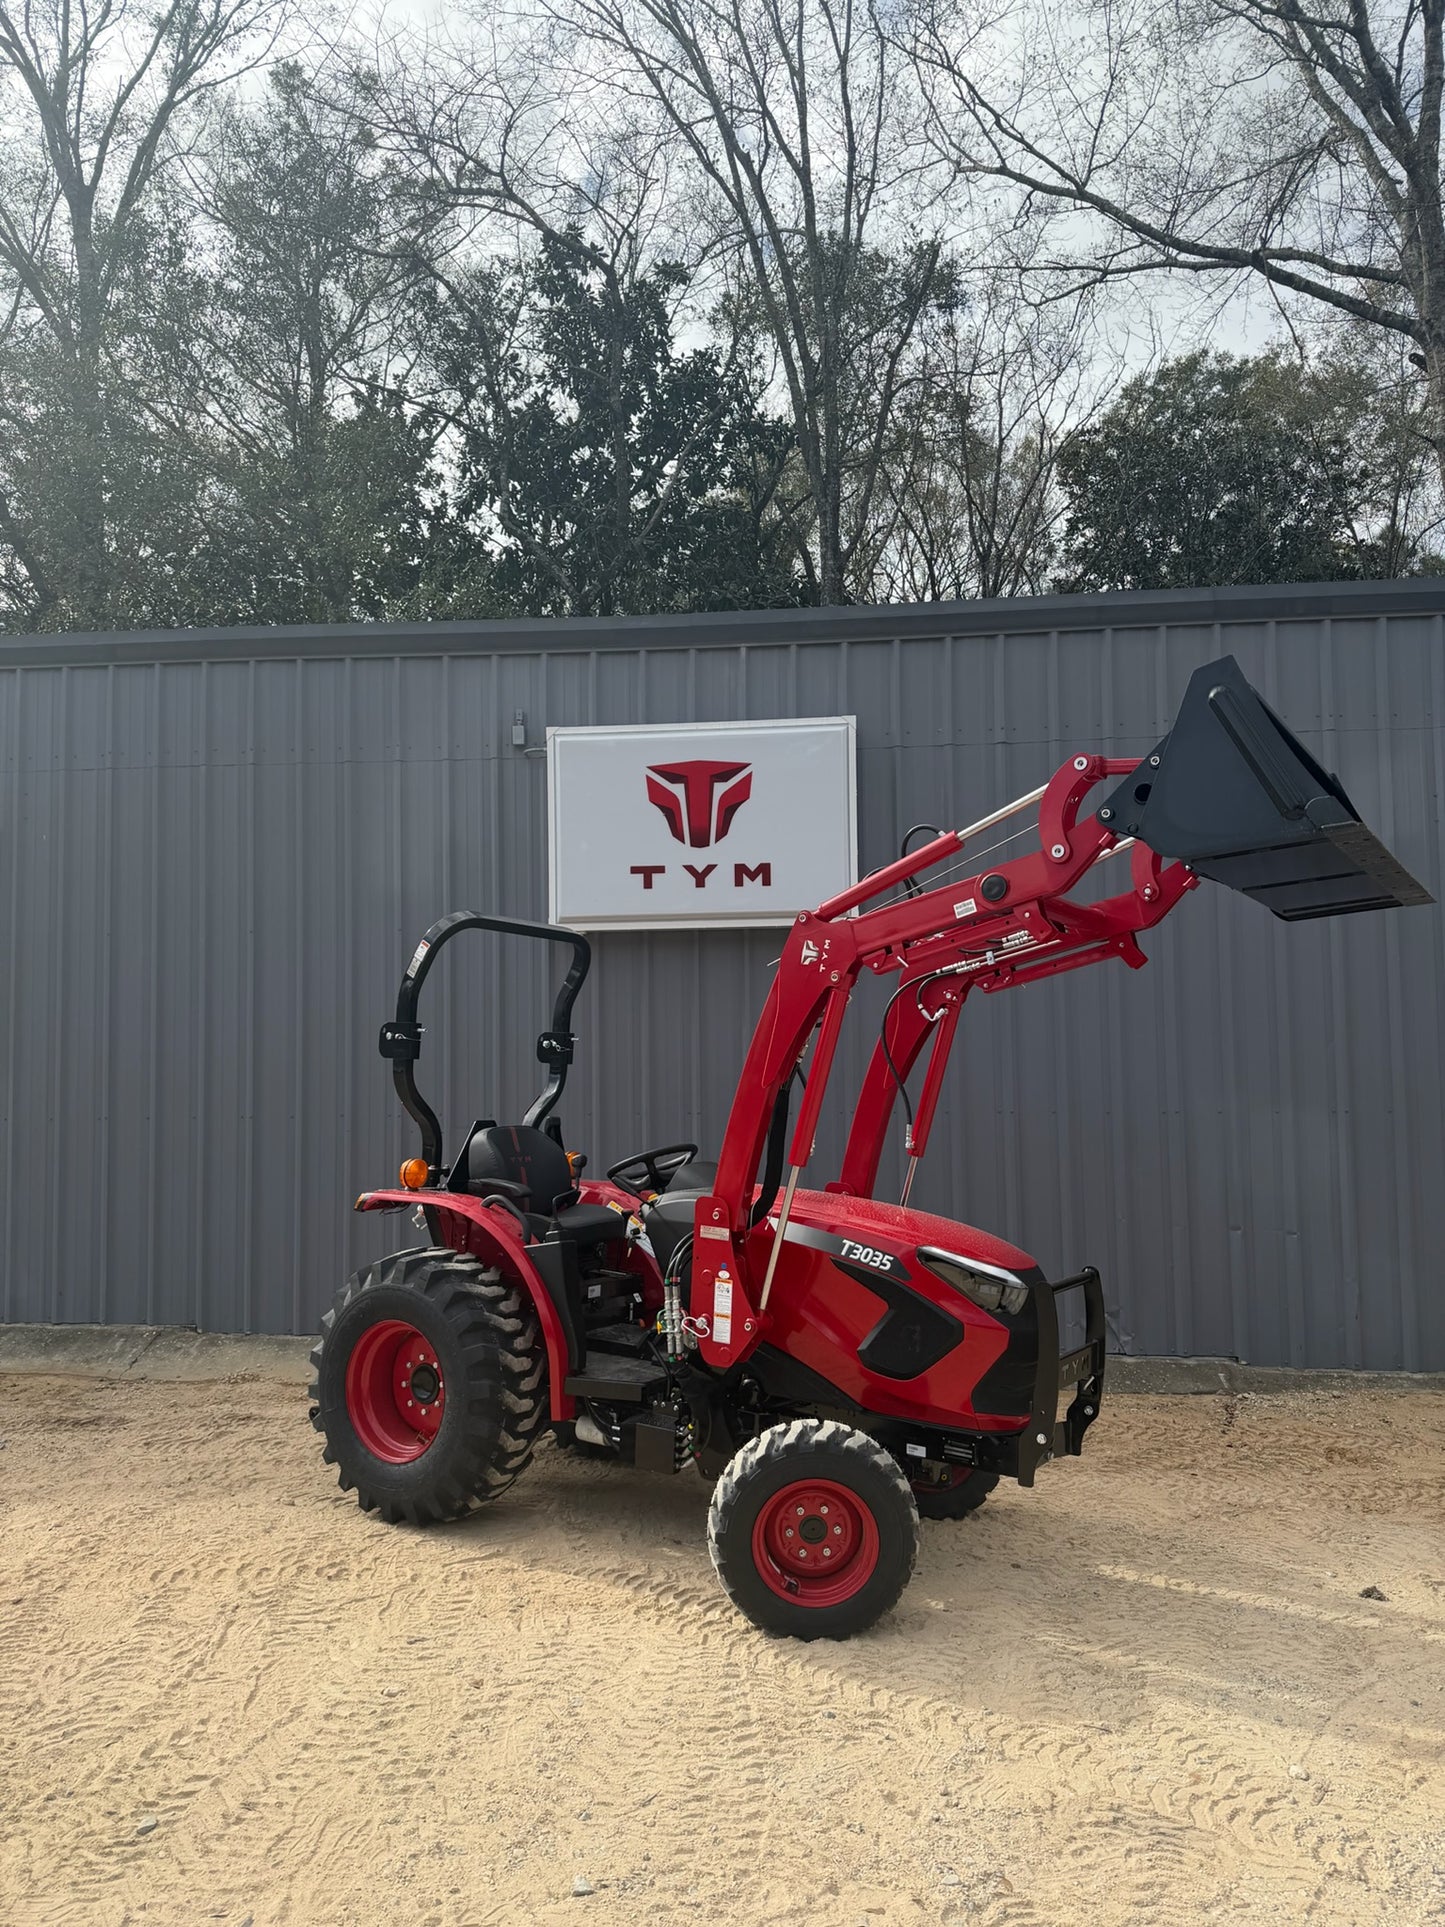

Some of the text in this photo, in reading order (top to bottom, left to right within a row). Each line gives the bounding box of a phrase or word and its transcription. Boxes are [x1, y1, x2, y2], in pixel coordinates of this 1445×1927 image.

[630, 862, 771, 889] TYM
[819, 939, 831, 972] TYM
[841, 1239, 894, 1271] T3035
